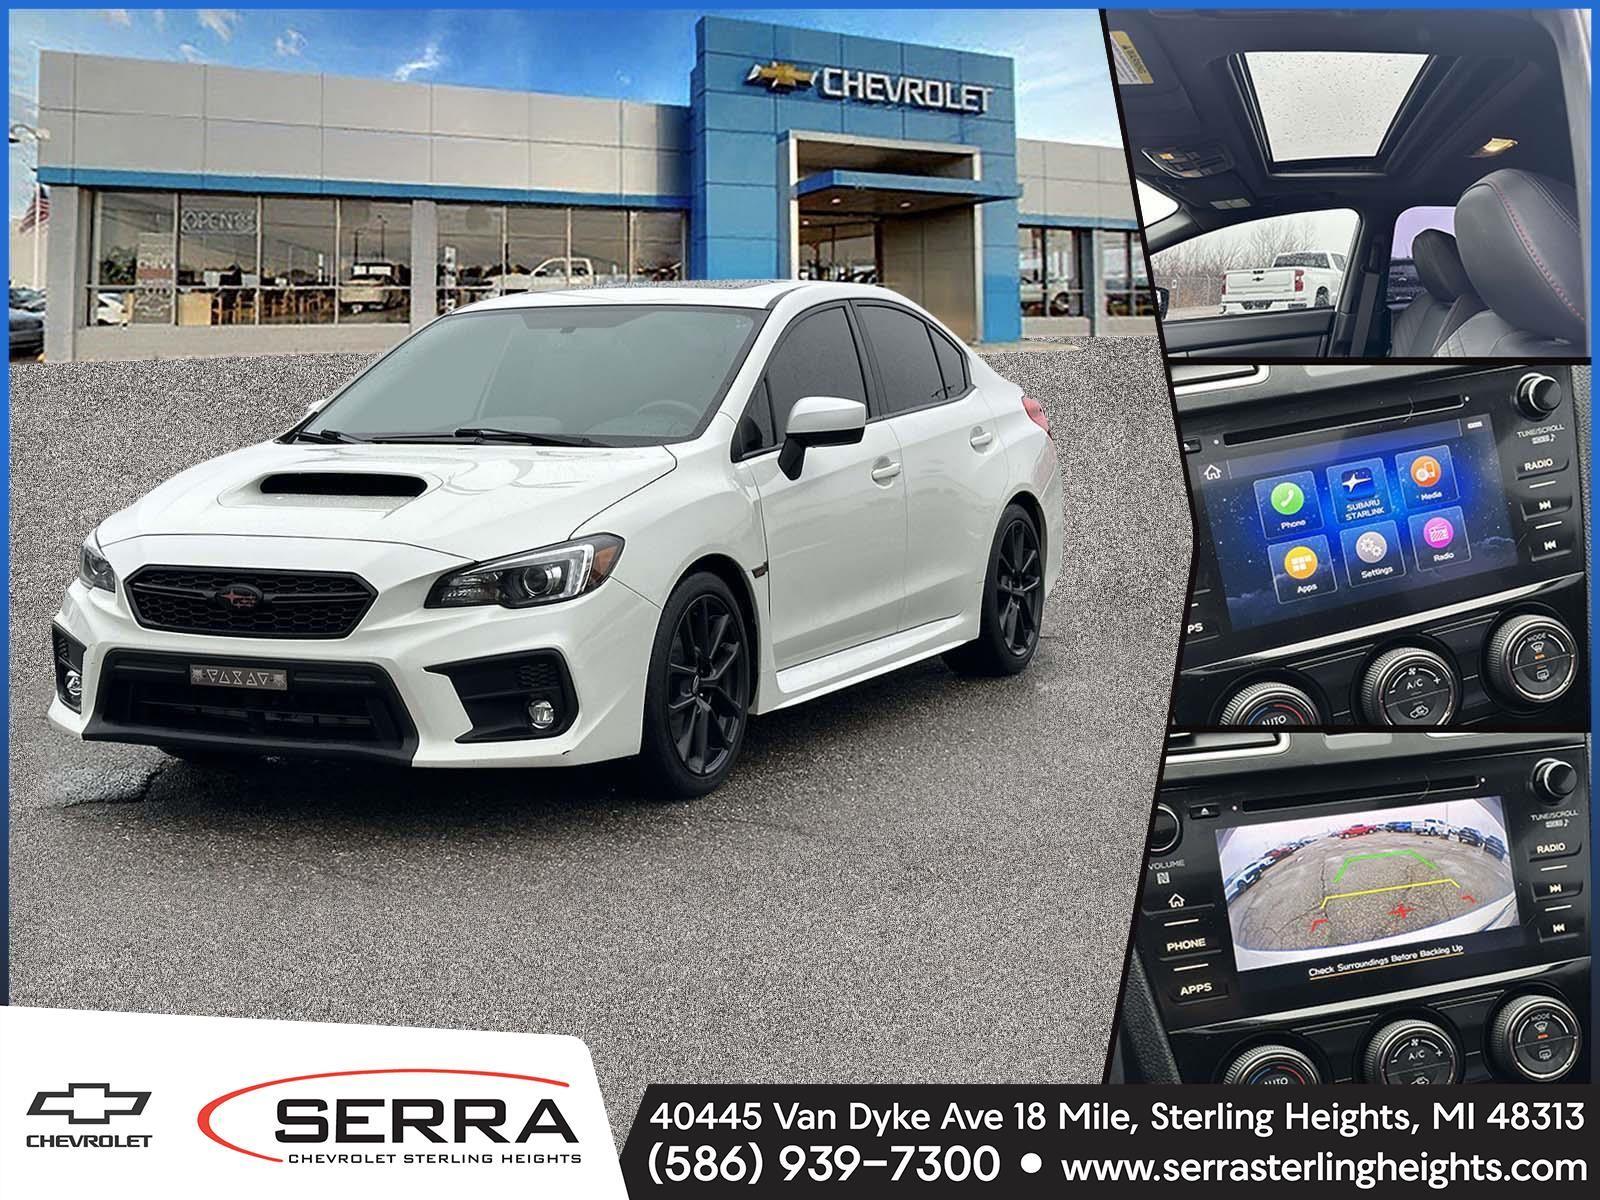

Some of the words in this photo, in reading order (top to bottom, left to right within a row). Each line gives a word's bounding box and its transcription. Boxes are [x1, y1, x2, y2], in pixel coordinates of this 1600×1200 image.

[822, 66, 993, 113] CHEVROLET
[1524, 458, 1553, 471] RADIO
[1347, 498, 1381, 512] SUBARU
[1345, 507, 1385, 521] STARLINK
[1280, 519, 1306, 530] Phone
[1433, 552, 1454, 562] Radio
[1361, 565, 1394, 580] Settings
[1297, 583, 1318, 594] Apps
[1407, 678, 1424, 690] A/C
[1536, 842, 1566, 854] RADIO
[1148, 859, 1185, 870] VOLUME
[1166, 937, 1207, 952] PHONE
[1308, 965, 1336, 977] Check
[1337, 956, 1389, 972] Surroundings
[1391, 952, 1418, 963] Before
[1420, 947, 1450, 958] Backing
[1452, 944, 1464, 953] Up
[1180, 982, 1213, 996] APPS
[1408, 1050, 1425, 1061] A/C
